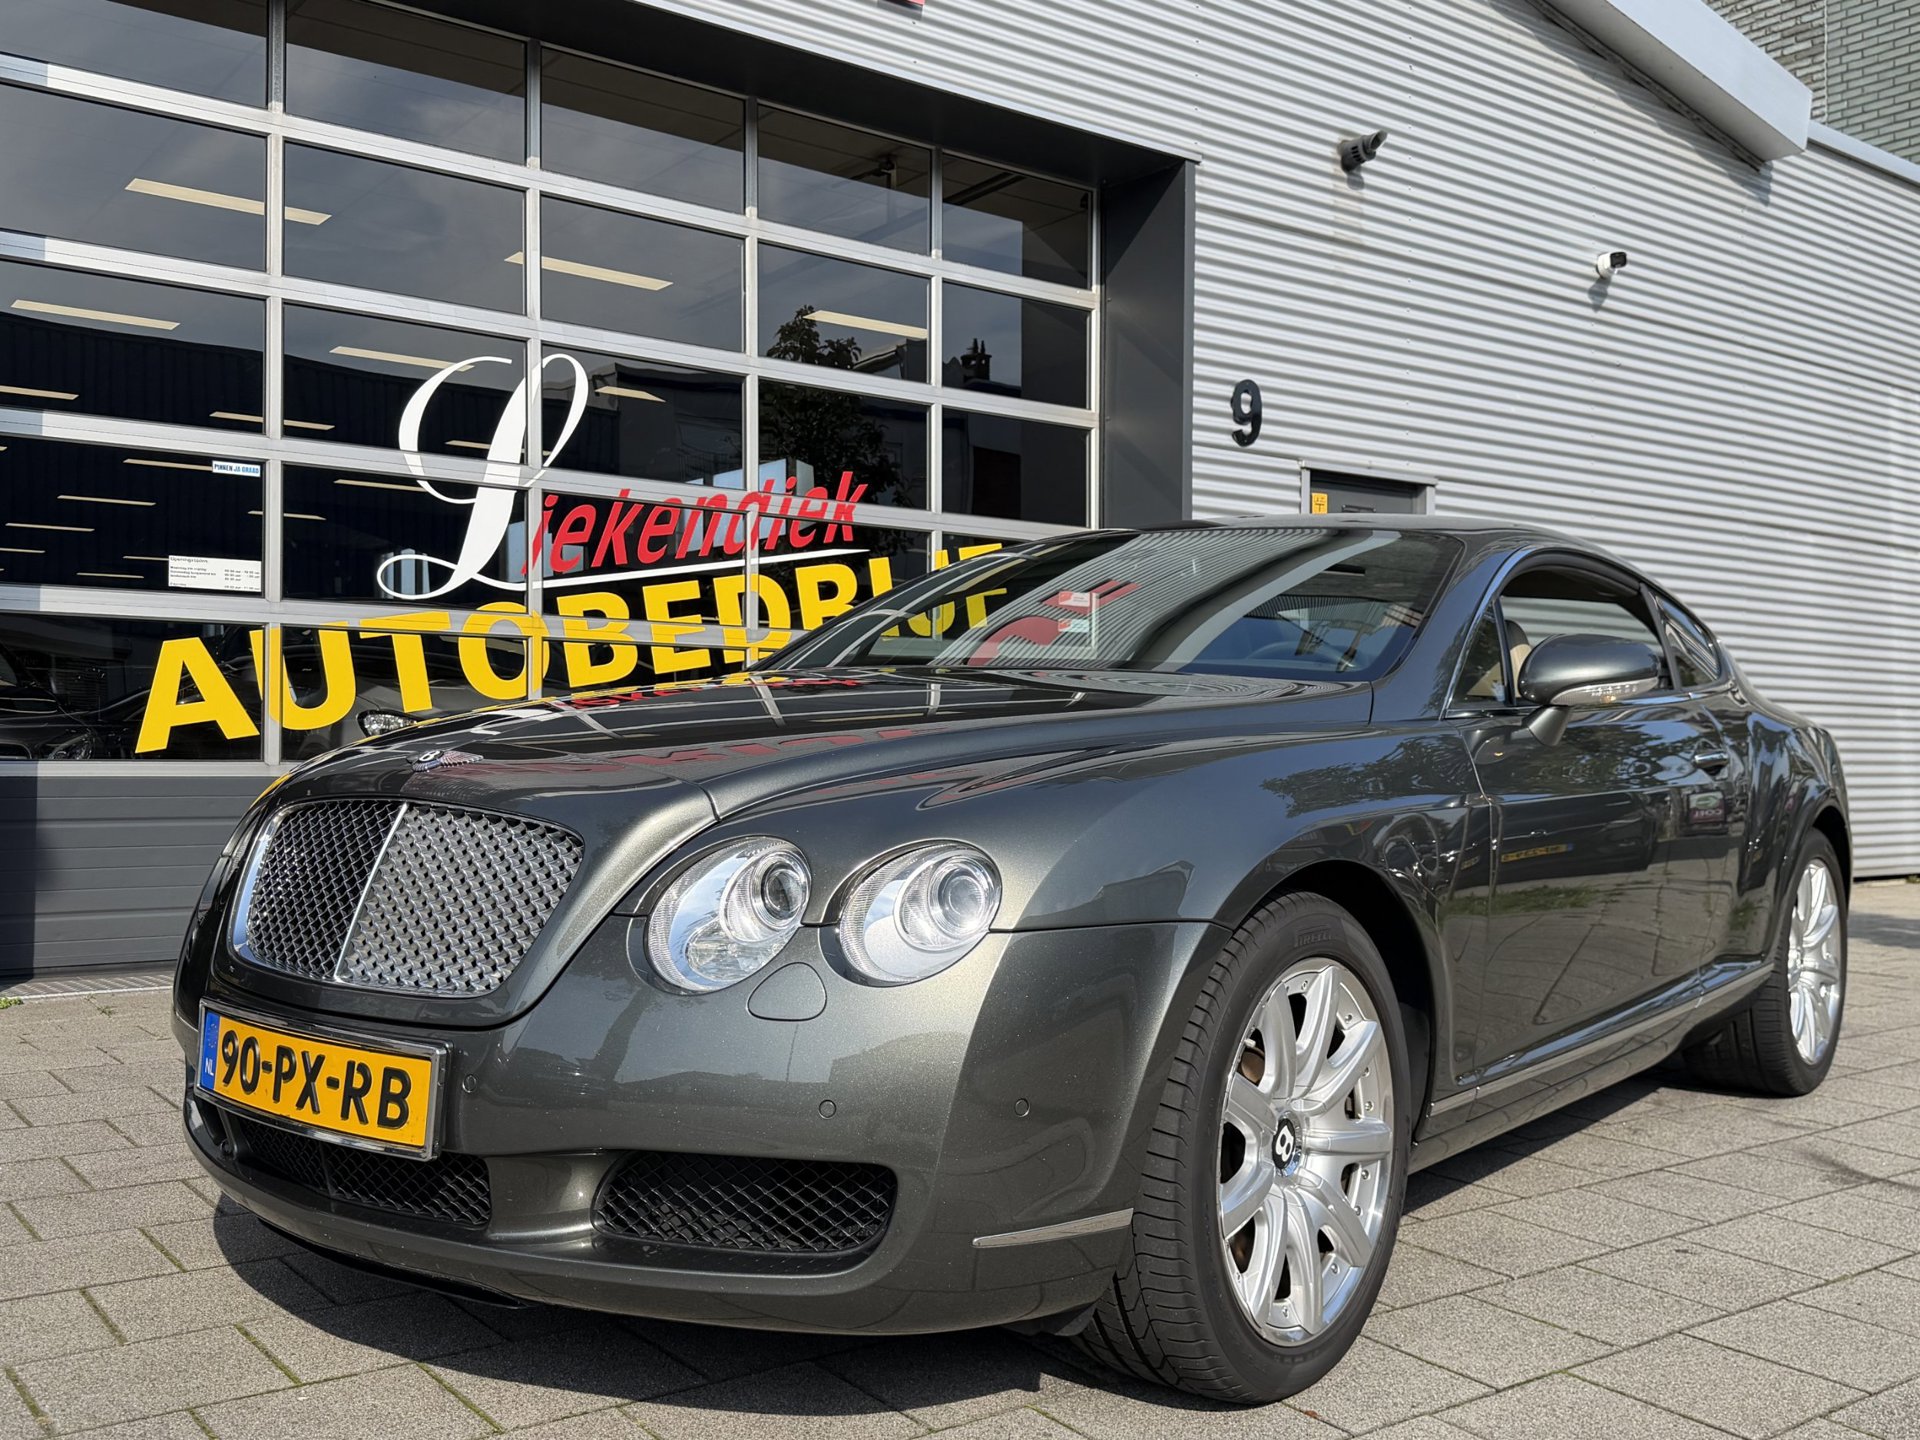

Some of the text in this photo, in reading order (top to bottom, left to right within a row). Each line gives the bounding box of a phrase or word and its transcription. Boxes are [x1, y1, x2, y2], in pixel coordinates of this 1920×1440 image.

[1230, 379, 1262, 447] 9
[376, 353, 869, 600] Liekendiek
[204, 1059, 215, 1077] NL
[221, 1029, 412, 1130] 90-PX-RB
